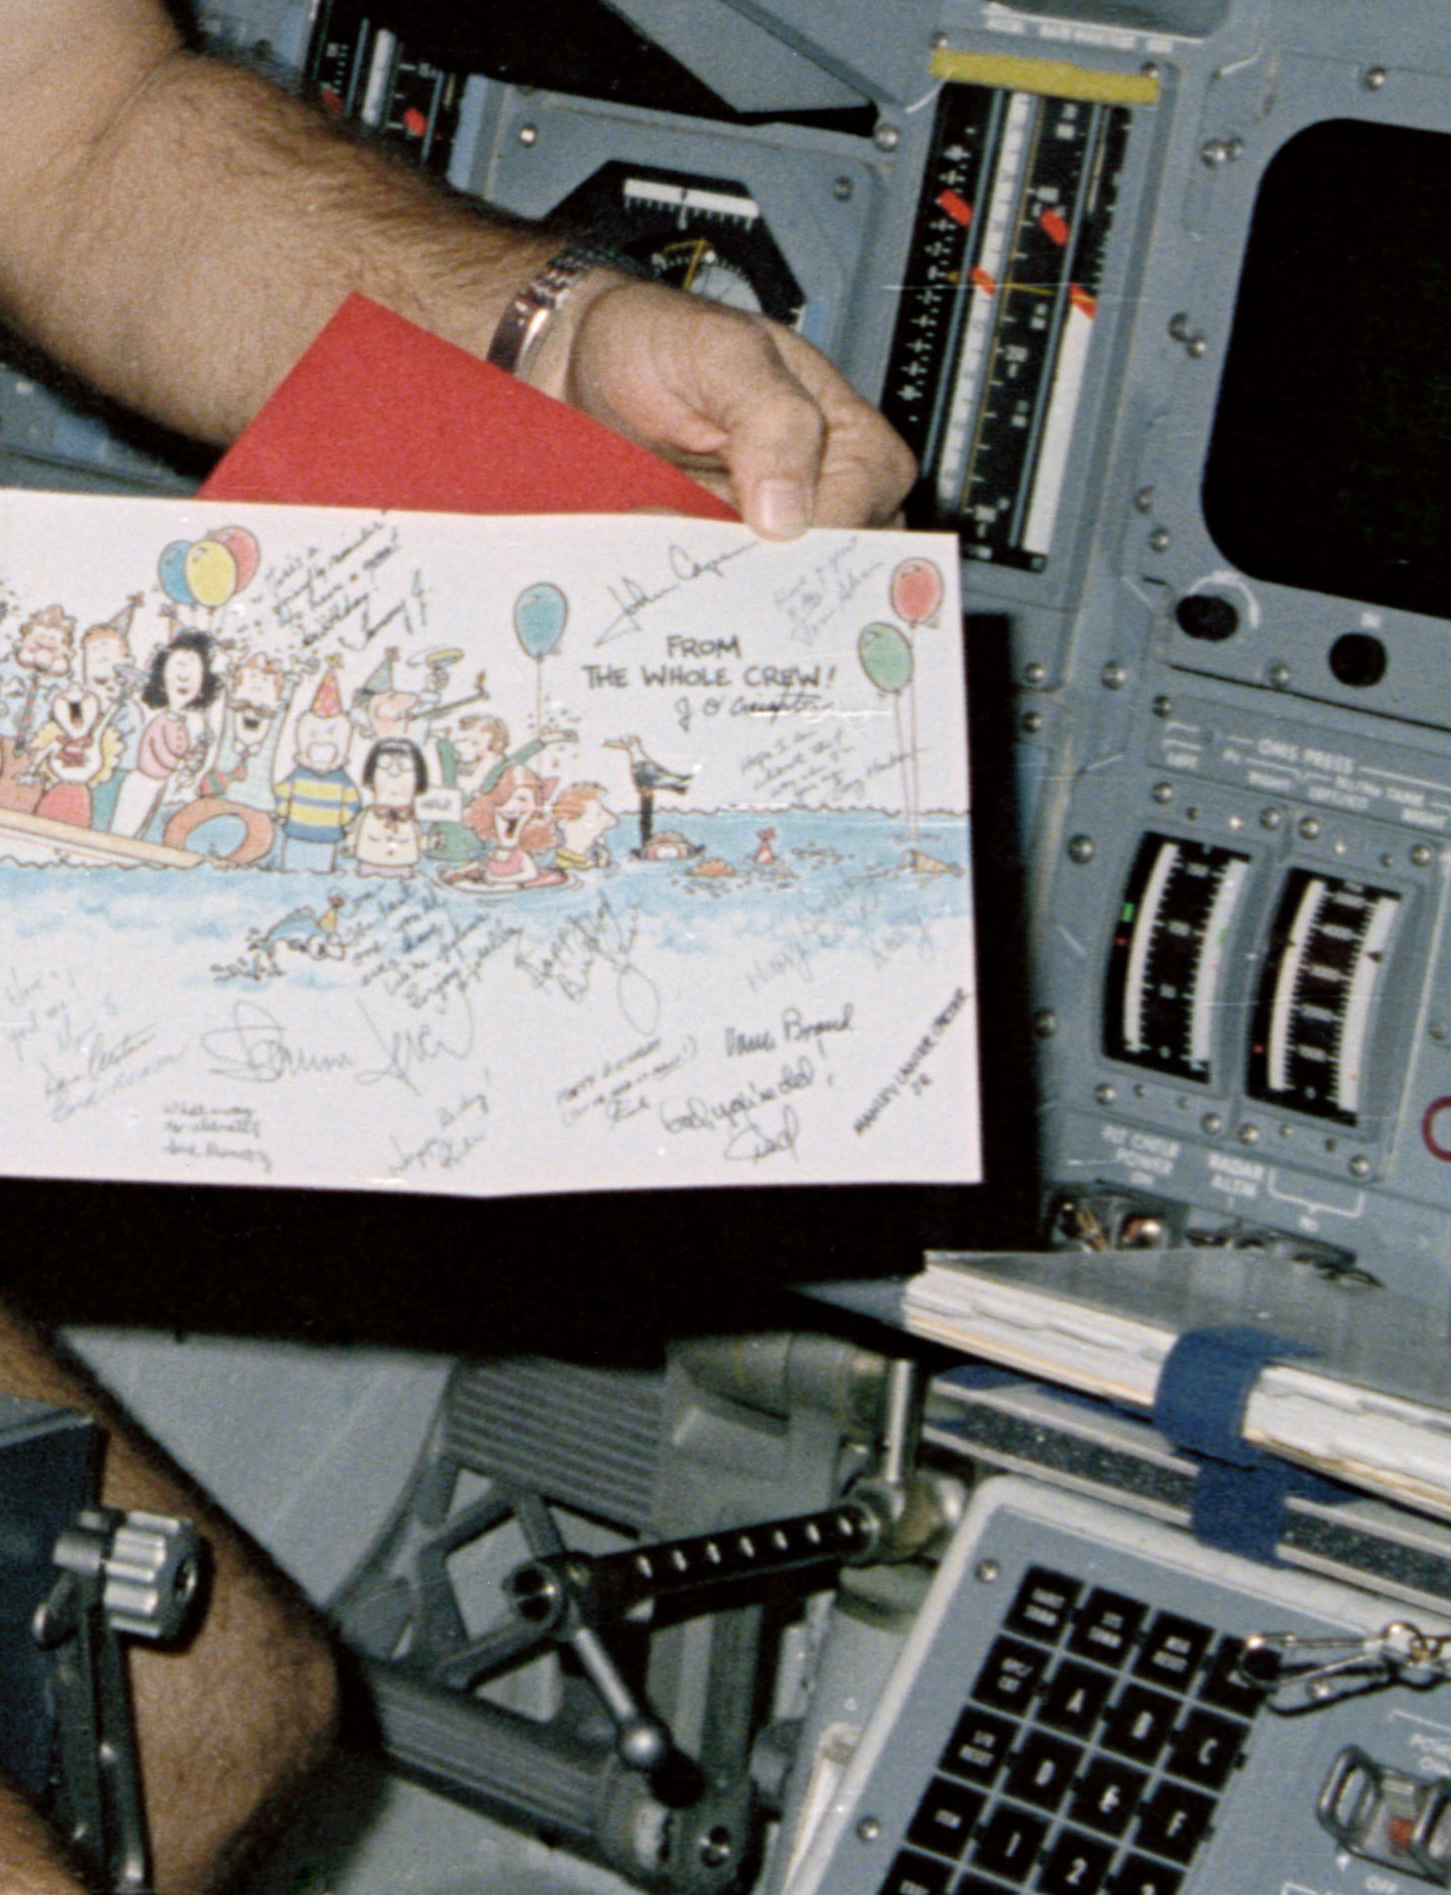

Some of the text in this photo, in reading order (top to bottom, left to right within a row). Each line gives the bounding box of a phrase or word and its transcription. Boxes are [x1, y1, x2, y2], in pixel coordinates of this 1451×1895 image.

[667, 634, 742, 659] FROM
[582, 664, 837, 688] THE WHOLE CREW!
[1303, 746, 1356, 774] PRESS
[1066, 1688, 1086, 1713] A
[1199, 1737, 1220, 1766] C
[1167, 1811, 1188, 1838] F
[1005, 1831, 1022, 1857] 1
[1066, 1858, 1088, 1886] 2
